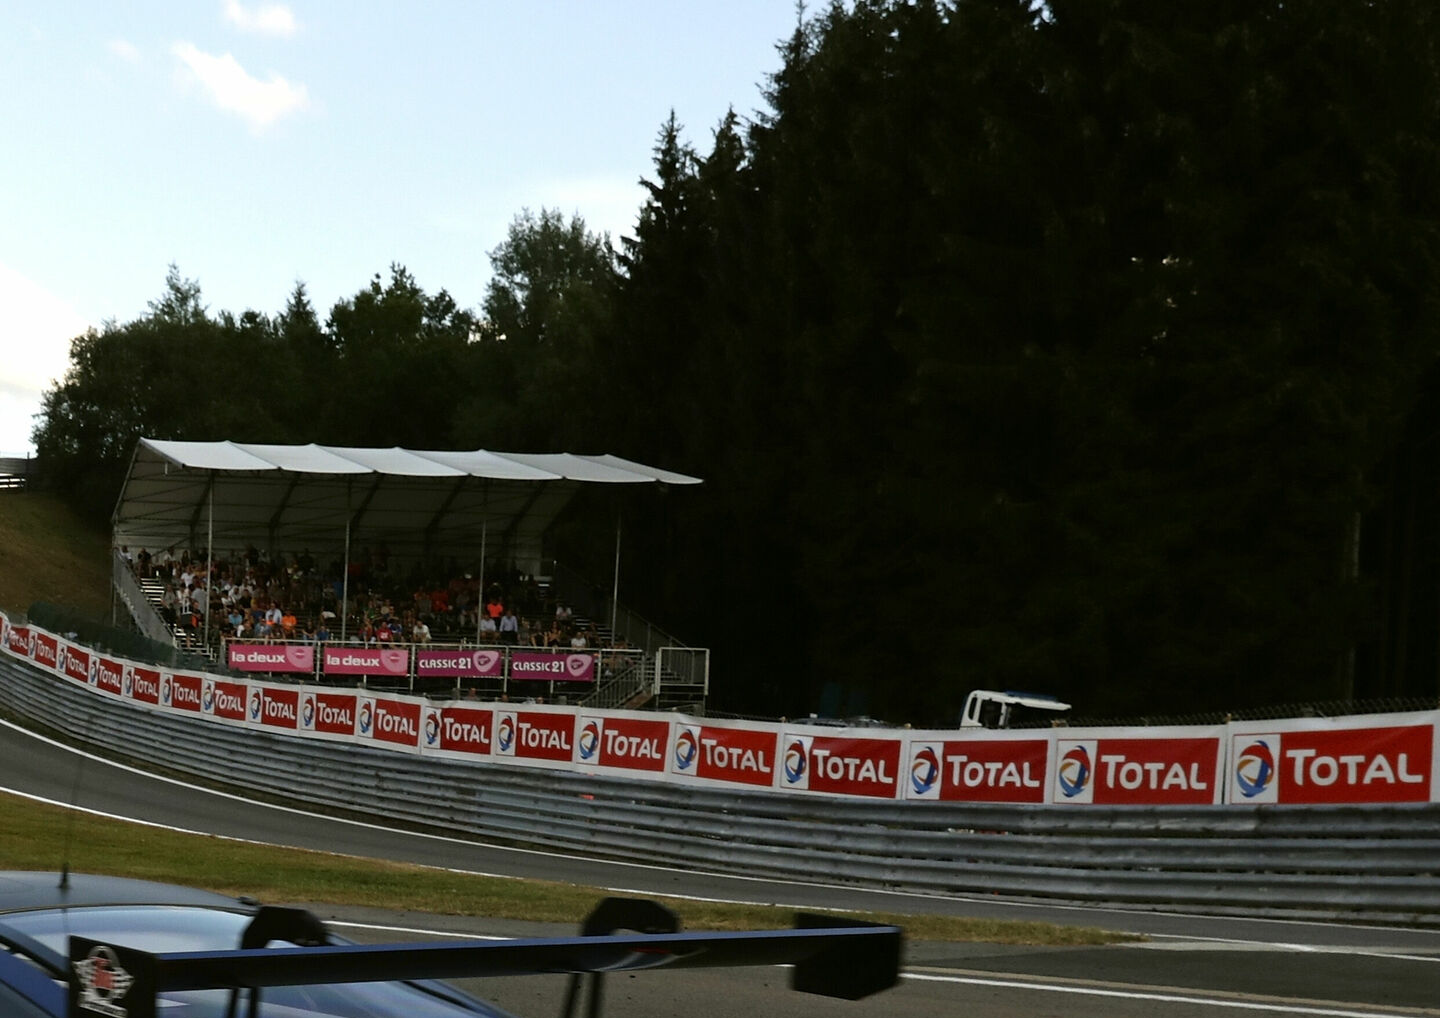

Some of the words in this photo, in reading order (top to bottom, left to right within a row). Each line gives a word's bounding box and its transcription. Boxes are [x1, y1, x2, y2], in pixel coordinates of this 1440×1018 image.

[66, 653, 87, 676] TOTAL
[231, 651, 245, 662] la
[248, 652, 286, 663] deux
[327, 655, 340, 665] la
[343, 656, 380, 667] deux
[419, 658, 457, 669] CLASSIC
[459, 658, 471, 669] 21
[512, 661, 550, 671] CLASSIC
[552, 661, 565, 672] 21
[99, 665, 121, 688] TOTAL
[134, 675, 158, 697] TOTAL
[173, 682, 200, 703] TOTAL
[215, 690, 244, 712] TOTAL
[264, 697, 295, 720] TOTAL
[318, 703, 352, 725] TOTAL
[376, 709, 417, 736] TOTAL
[444, 718, 490, 744] TOTAL
[519, 723, 571, 750] TOTAL
[605, 729, 661, 759] TOTAL
[702, 739, 771, 773] TOTAL
[813, 750, 893, 784] TOTAL
[1287, 748, 1423, 785] TOTAL
[948, 754, 1040, 788] TOTAL
[1101, 754, 1207, 791] TOTAL
